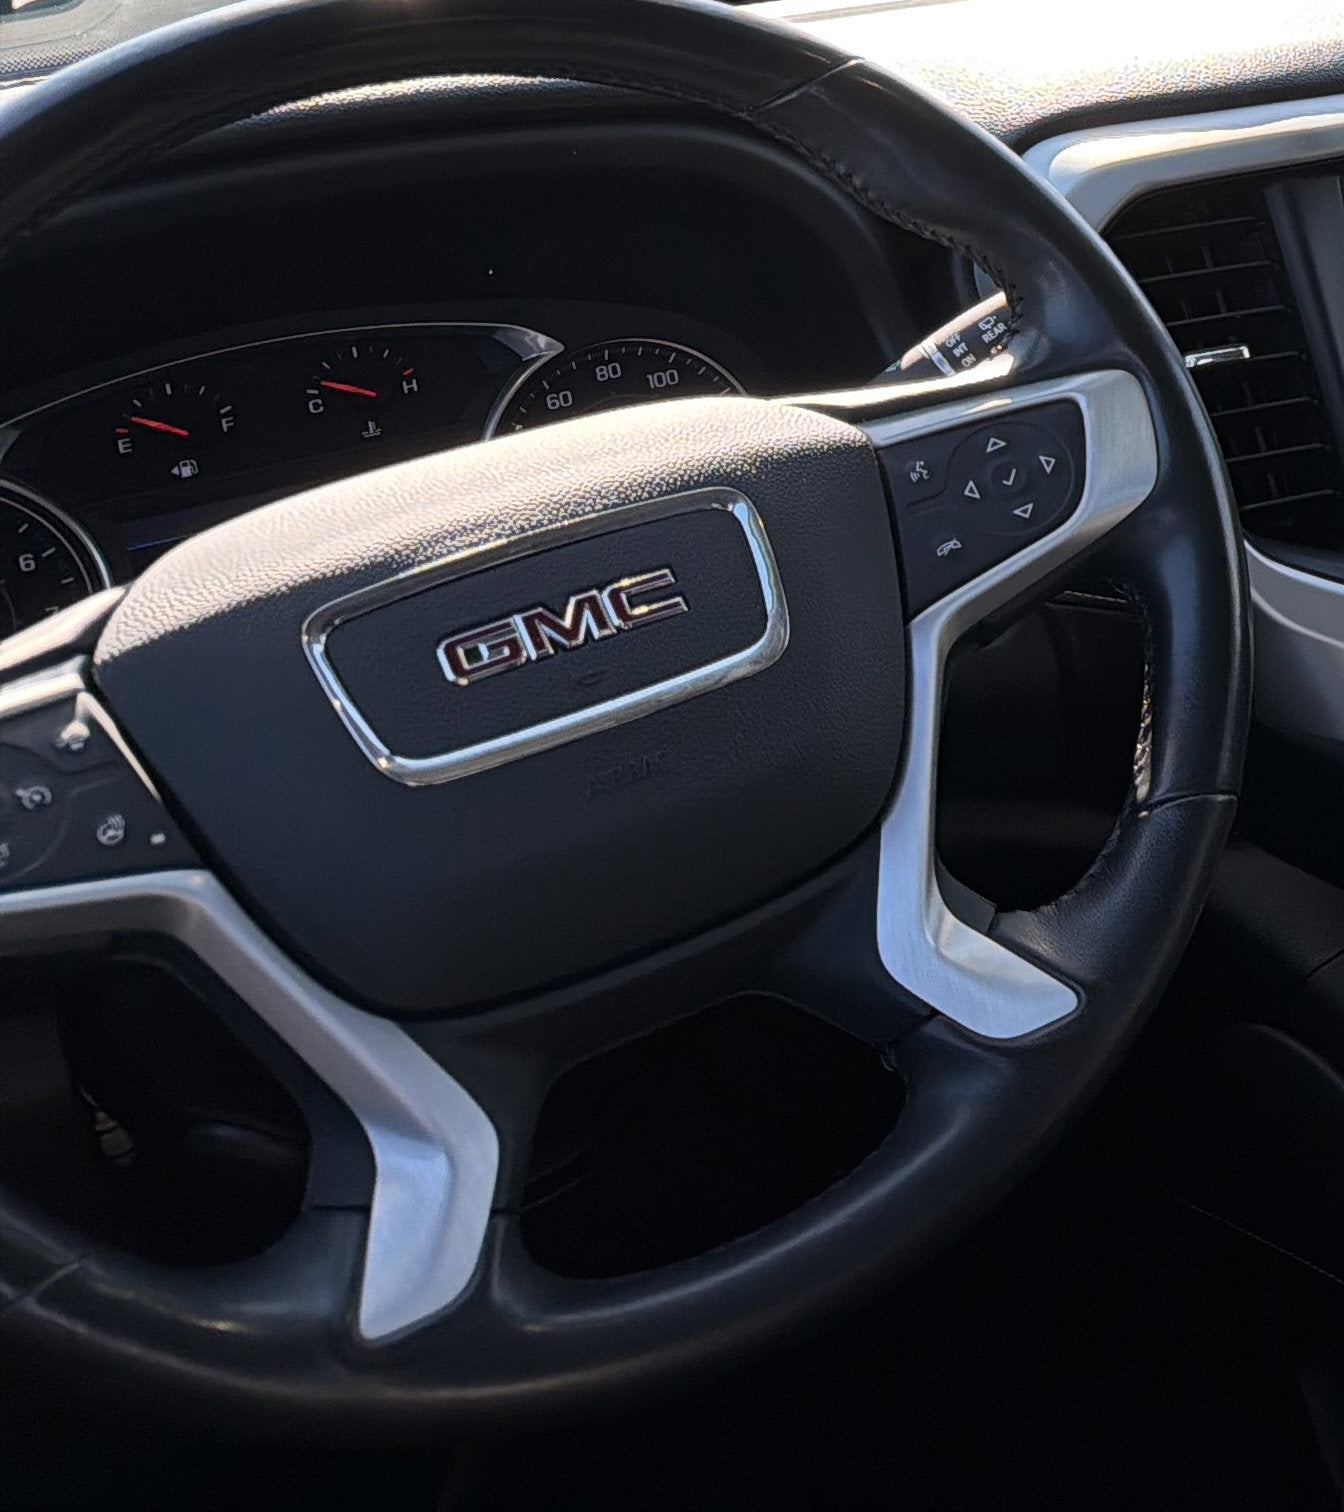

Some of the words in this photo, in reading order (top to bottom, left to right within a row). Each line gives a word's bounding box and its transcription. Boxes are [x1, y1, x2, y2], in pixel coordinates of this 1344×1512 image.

[982, 322, 1008, 343] REAR
[953, 342, 968, 358] INT
[961, 353, 976, 367] ON
[595, 362, 621, 382] 80
[646, 369, 679, 390] 100
[403, 378, 418, 394] H
[308, 397, 324, 415] C
[545, 390, 573, 410] 60
[222, 416, 235, 434] F
[118, 436, 134, 455] E
[19, 553, 36, 572] 6
[437, 568, 689, 686] GMC
